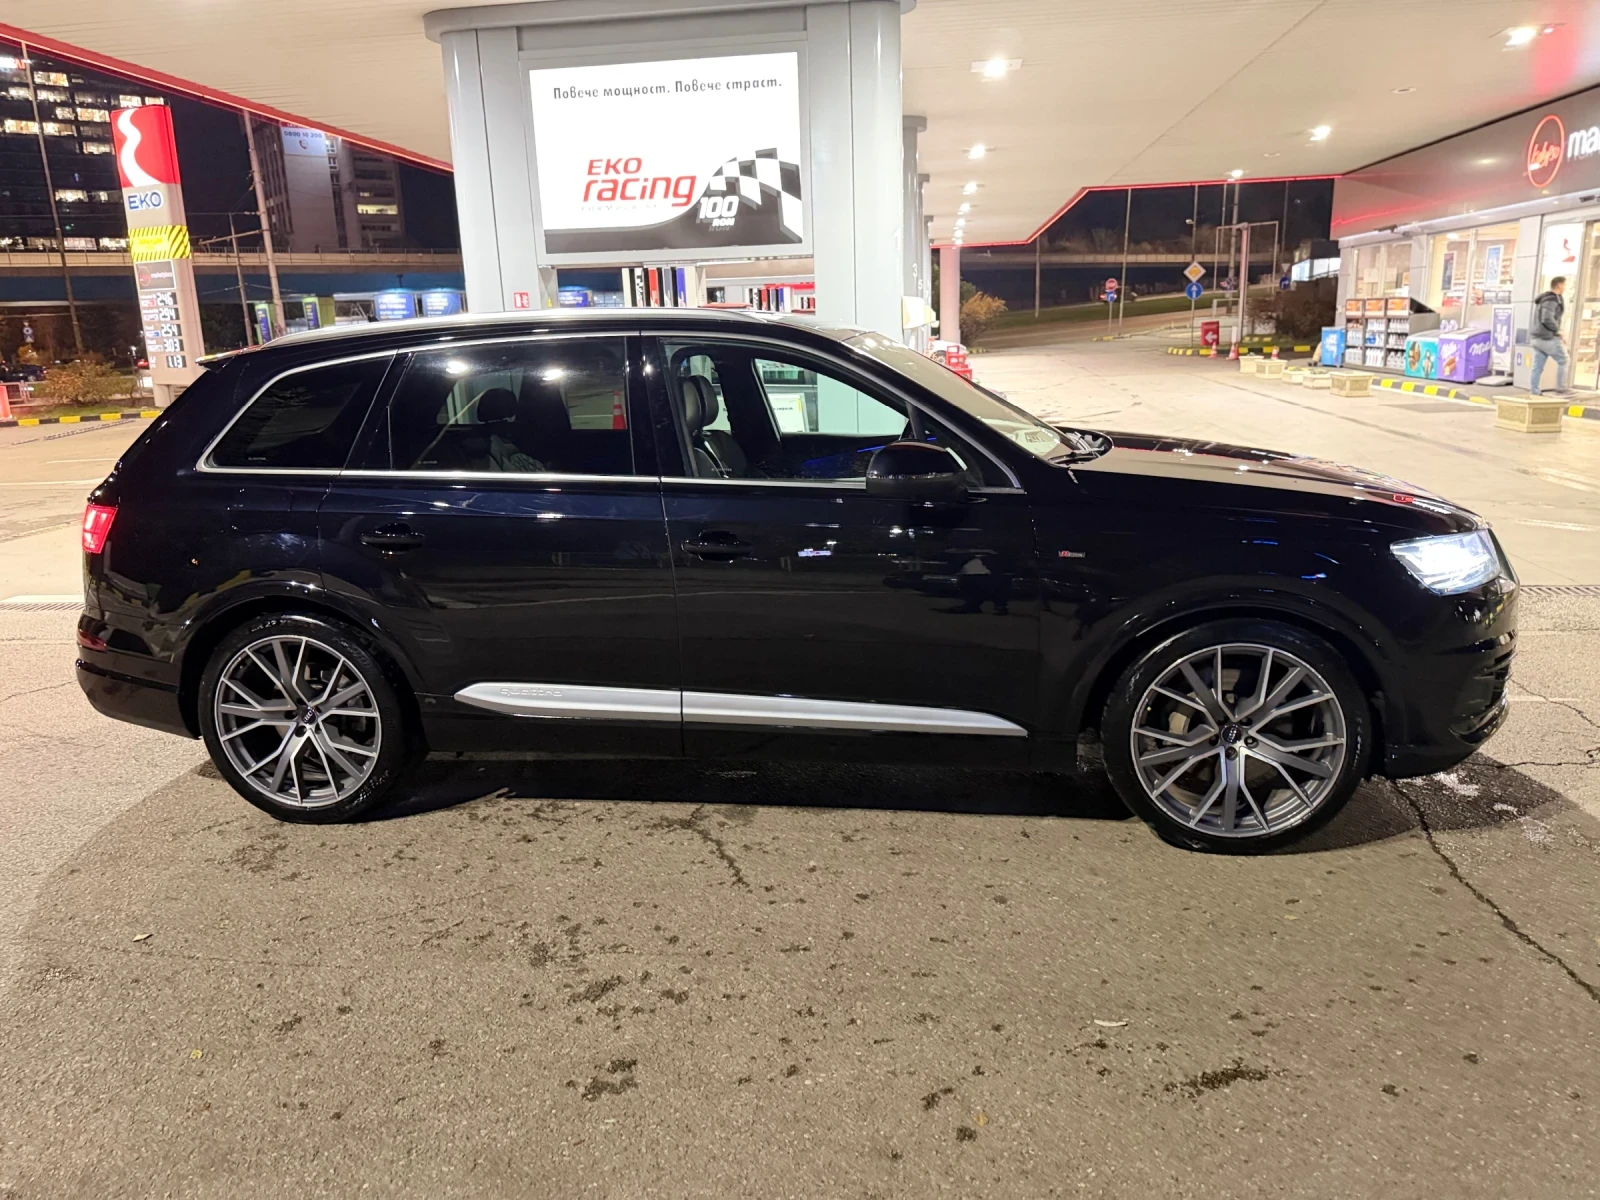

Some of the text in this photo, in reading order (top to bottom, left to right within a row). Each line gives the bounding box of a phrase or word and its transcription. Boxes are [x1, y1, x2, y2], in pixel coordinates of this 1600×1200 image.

[553, 79, 782, 99] Повече мощност. Повече страст.
[1567, 126, 1600, 159] ma
[587, 157, 643, 176] EKO
[128, 191, 162, 210] EKO
[583, 175, 697, 208] racing
[700, 195, 740, 219] 100
[712, 217, 736, 227] RON
[912, 263, 918, 278] 3
[917, 279, 924, 290] 5
[500, 687, 562, 697] quattro
